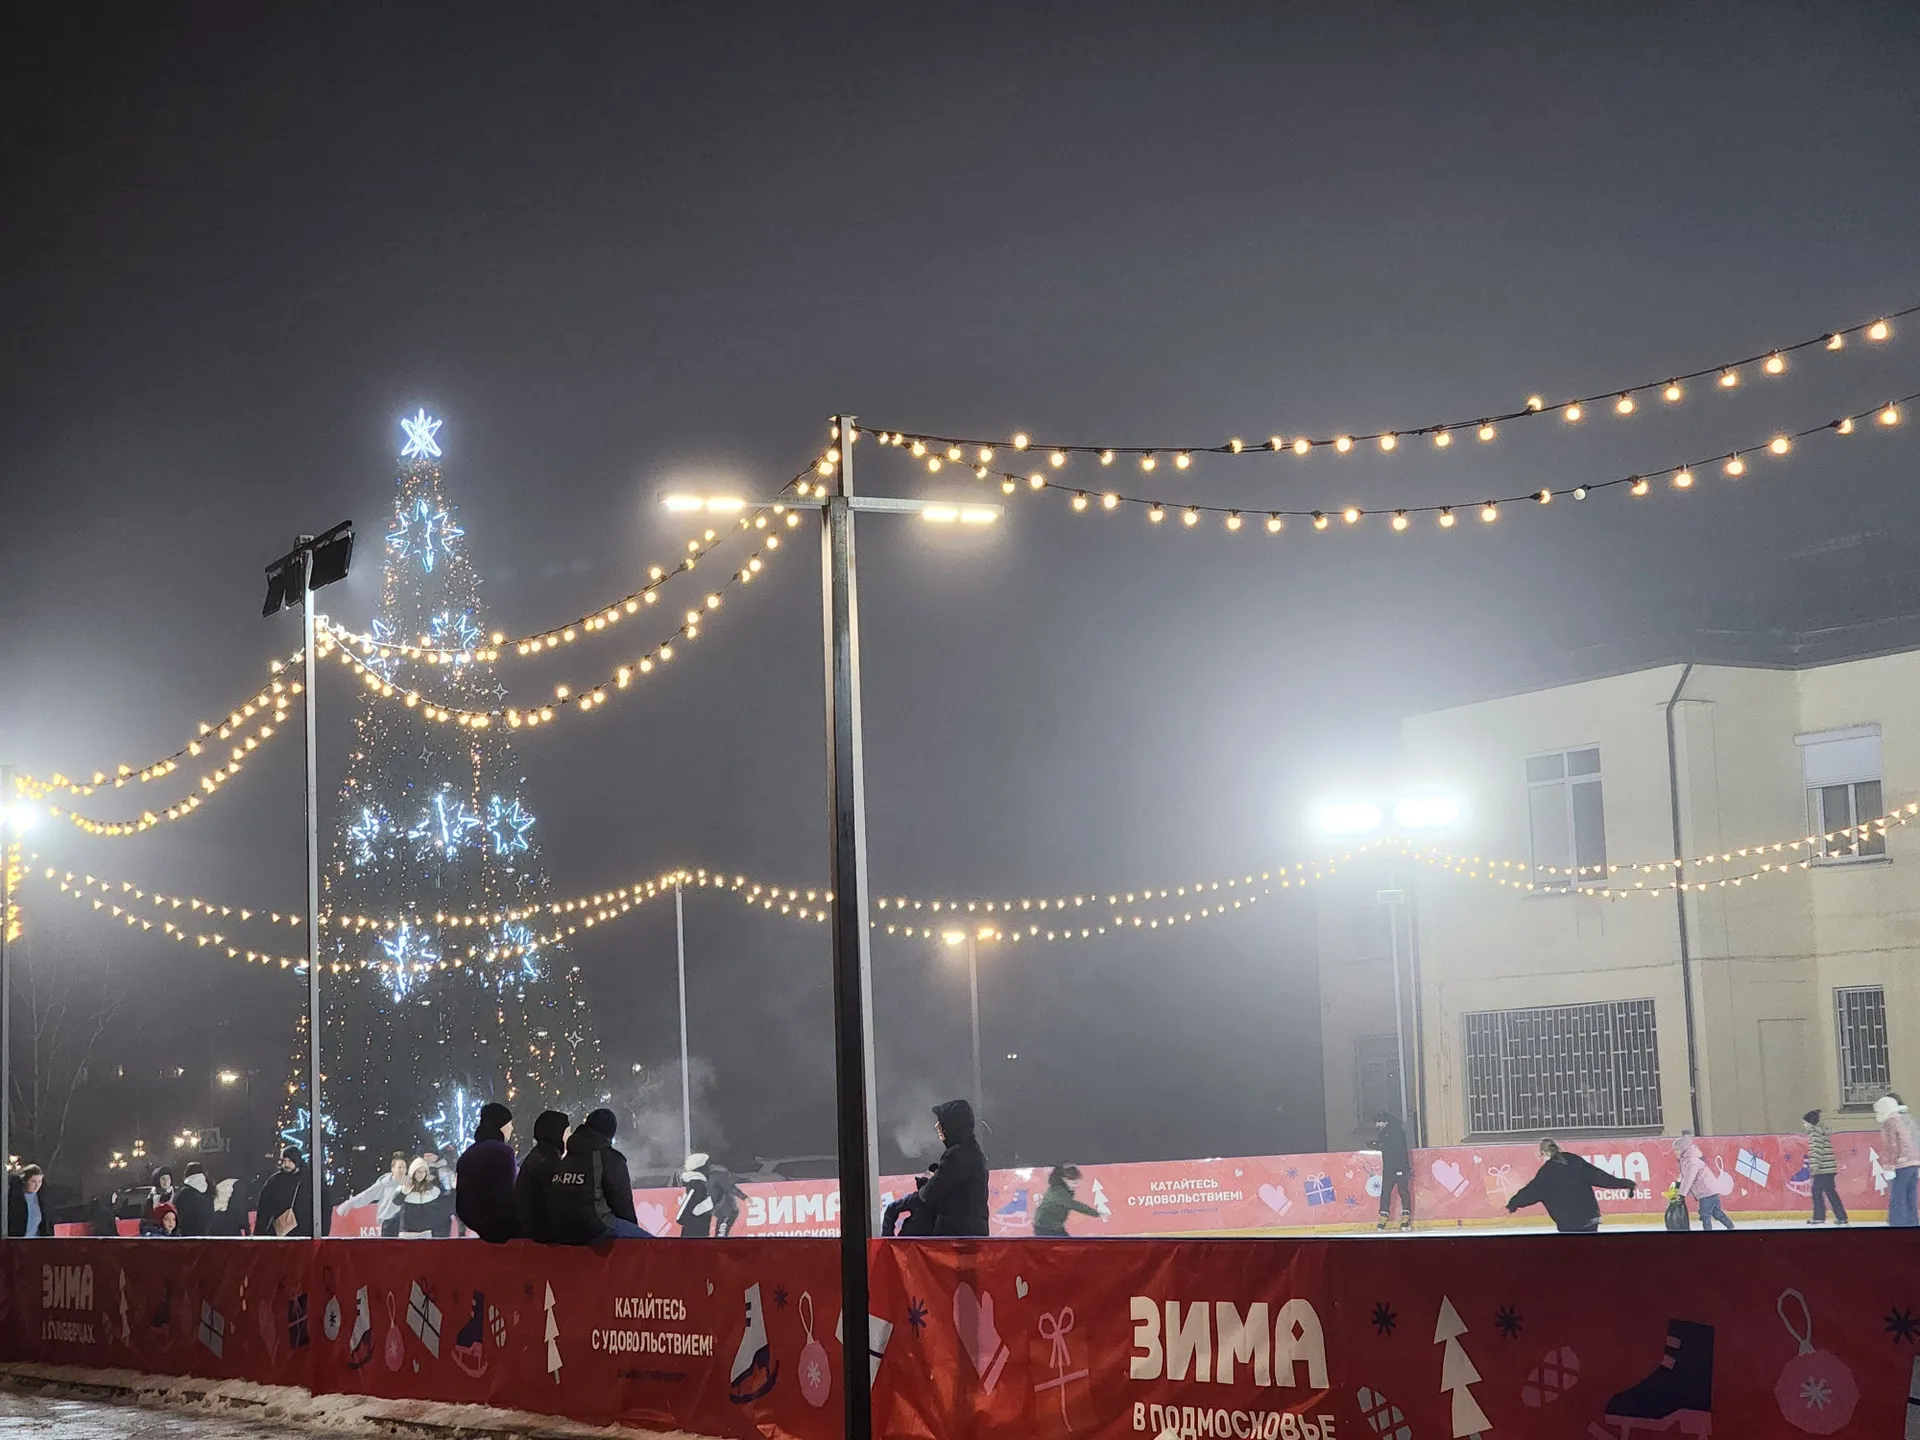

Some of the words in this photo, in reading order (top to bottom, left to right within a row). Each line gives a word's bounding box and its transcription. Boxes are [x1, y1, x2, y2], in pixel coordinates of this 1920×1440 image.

[551, 1172, 586, 1185] PARIS
[1581, 1151, 1650, 1182] МА
[1127, 1196, 1136, 1206] С
[1138, 1190, 1243, 1207] УДОВОЛЬСТВИЕМ!
[1150, 1178, 1219, 1191] КАТАЙТЕСЬ
[42, 1264, 94, 1311] ЗИМА
[615, 1292, 687, 1321] КАТАЙТЕСЬ
[592, 1329, 600, 1350] С
[602, 1330, 713, 1357] УДОВОЛЬСТВИЕМ!
[1130, 1296, 1330, 1389] ЗИМА
[1133, 1402, 1146, 1431] В
[1150, 1403, 1336, 1440] ПОДМОСКОВЬЕ
